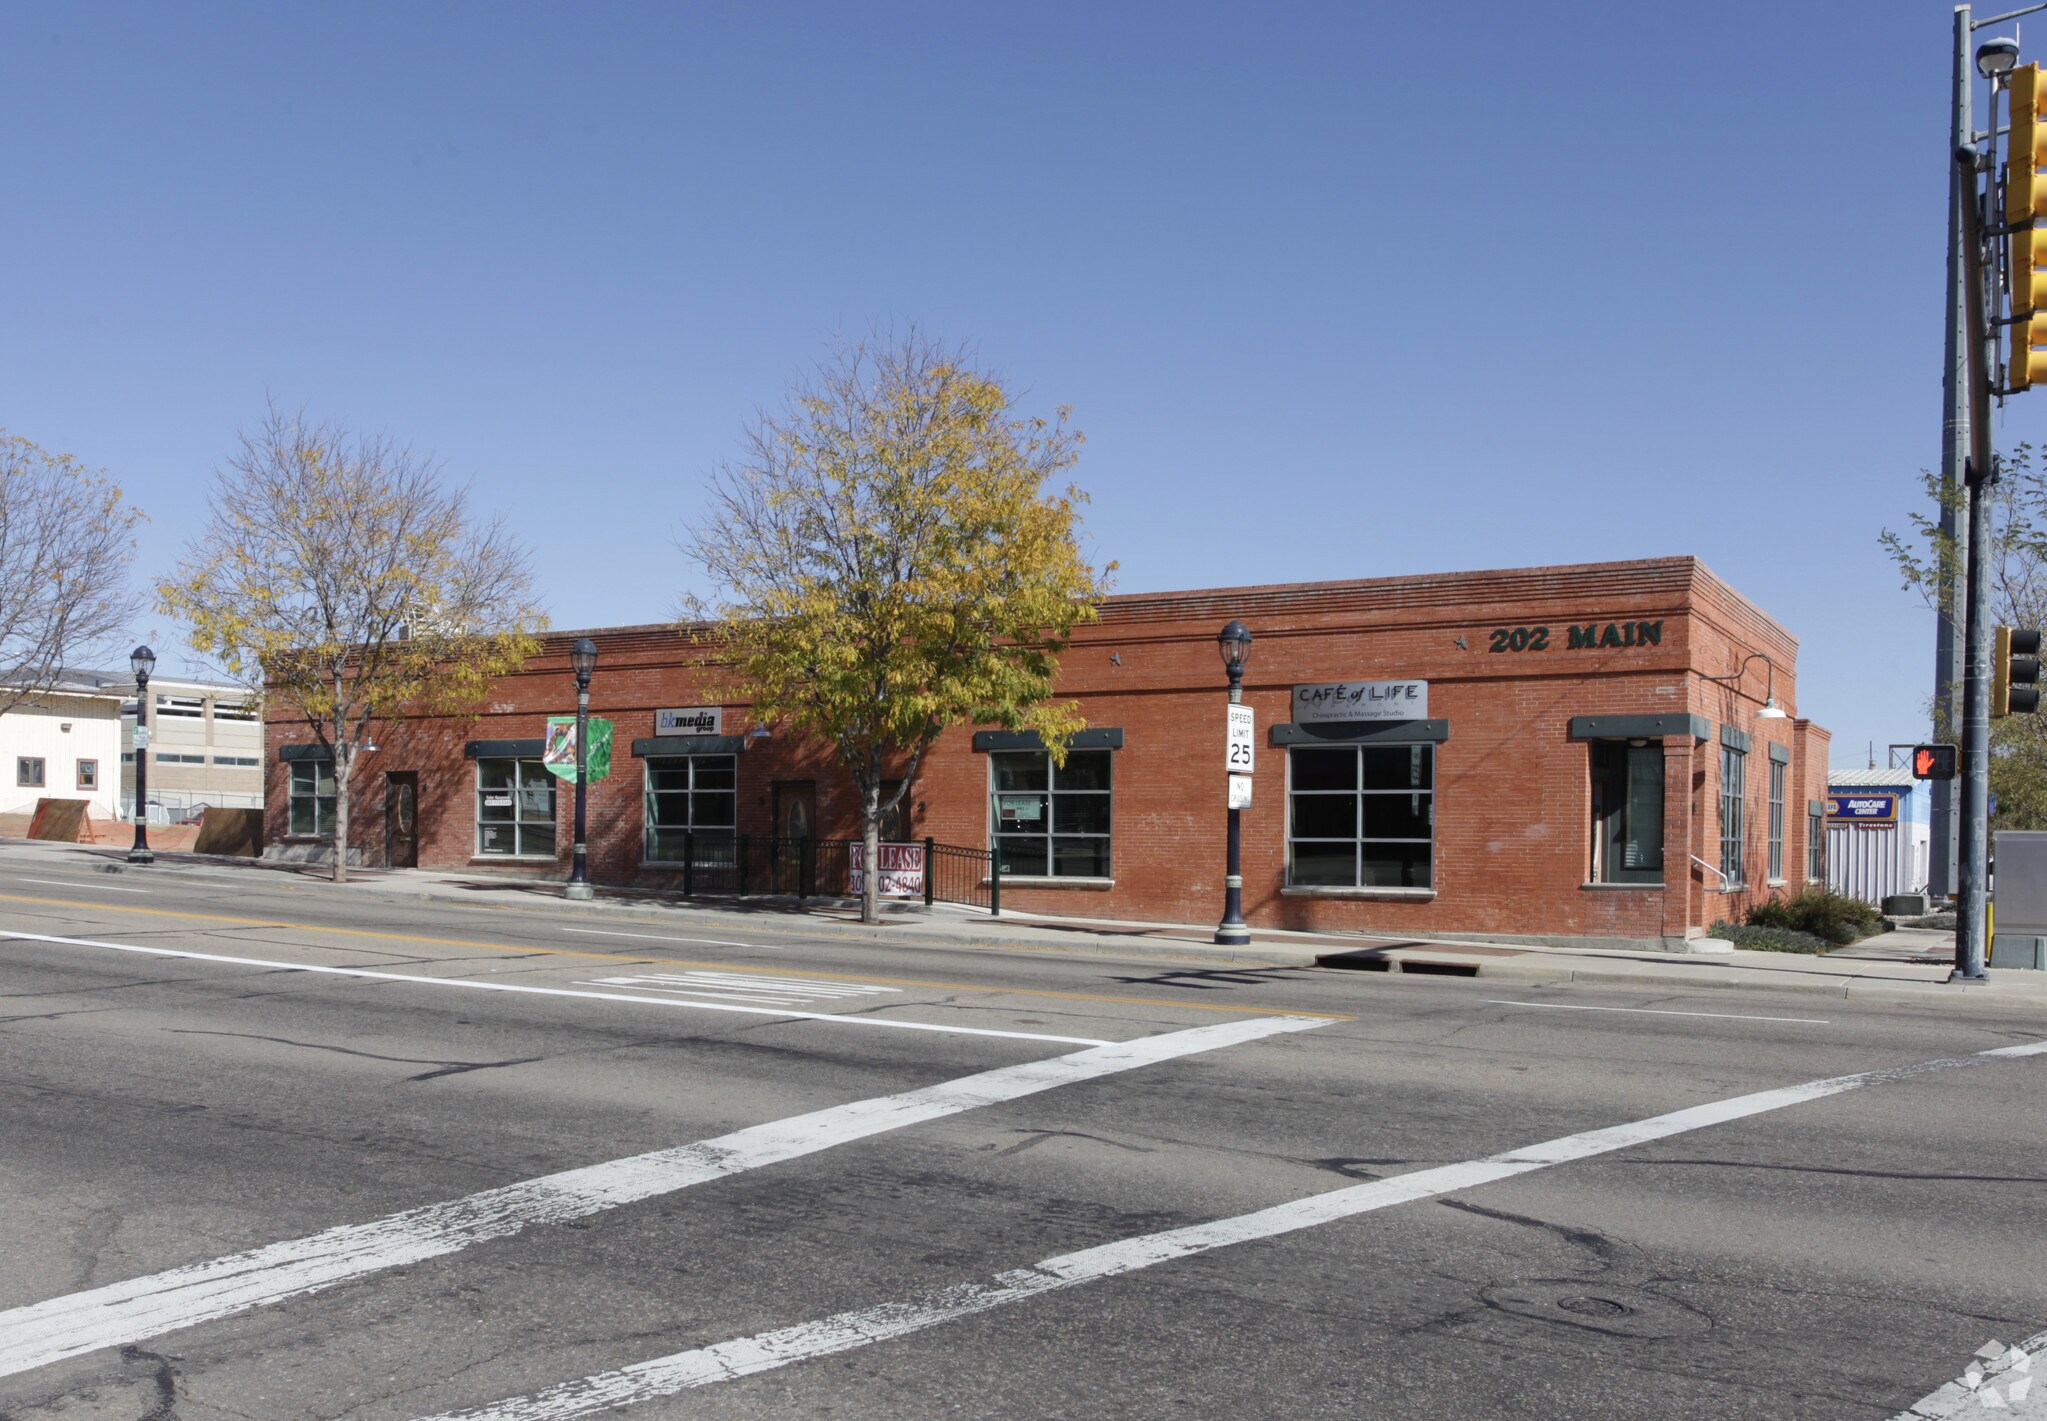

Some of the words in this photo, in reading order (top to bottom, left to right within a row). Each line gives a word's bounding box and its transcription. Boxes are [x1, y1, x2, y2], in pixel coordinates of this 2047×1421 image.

[1488, 626, 1549, 653] 202
[1566, 620, 1664, 650] MAIN
[1299, 684, 1347, 701] CAFÉ
[1351, 687, 1365, 702] of
[1369, 685, 1418, 700] LIFE
[1230, 712, 1251, 724] SPEED
[1312, 711, 1347, 719] Chiropractic
[1354, 710, 1381, 718] Massage
[1232, 728, 1249, 738] LIMIT
[1230, 743, 1250, 764] 25
[1236, 782, 1244, 791] NO
[1230, 794, 1250, 803] CRUISING
[852, 846, 864, 869] FO
[880, 847, 920, 870] LEASE
